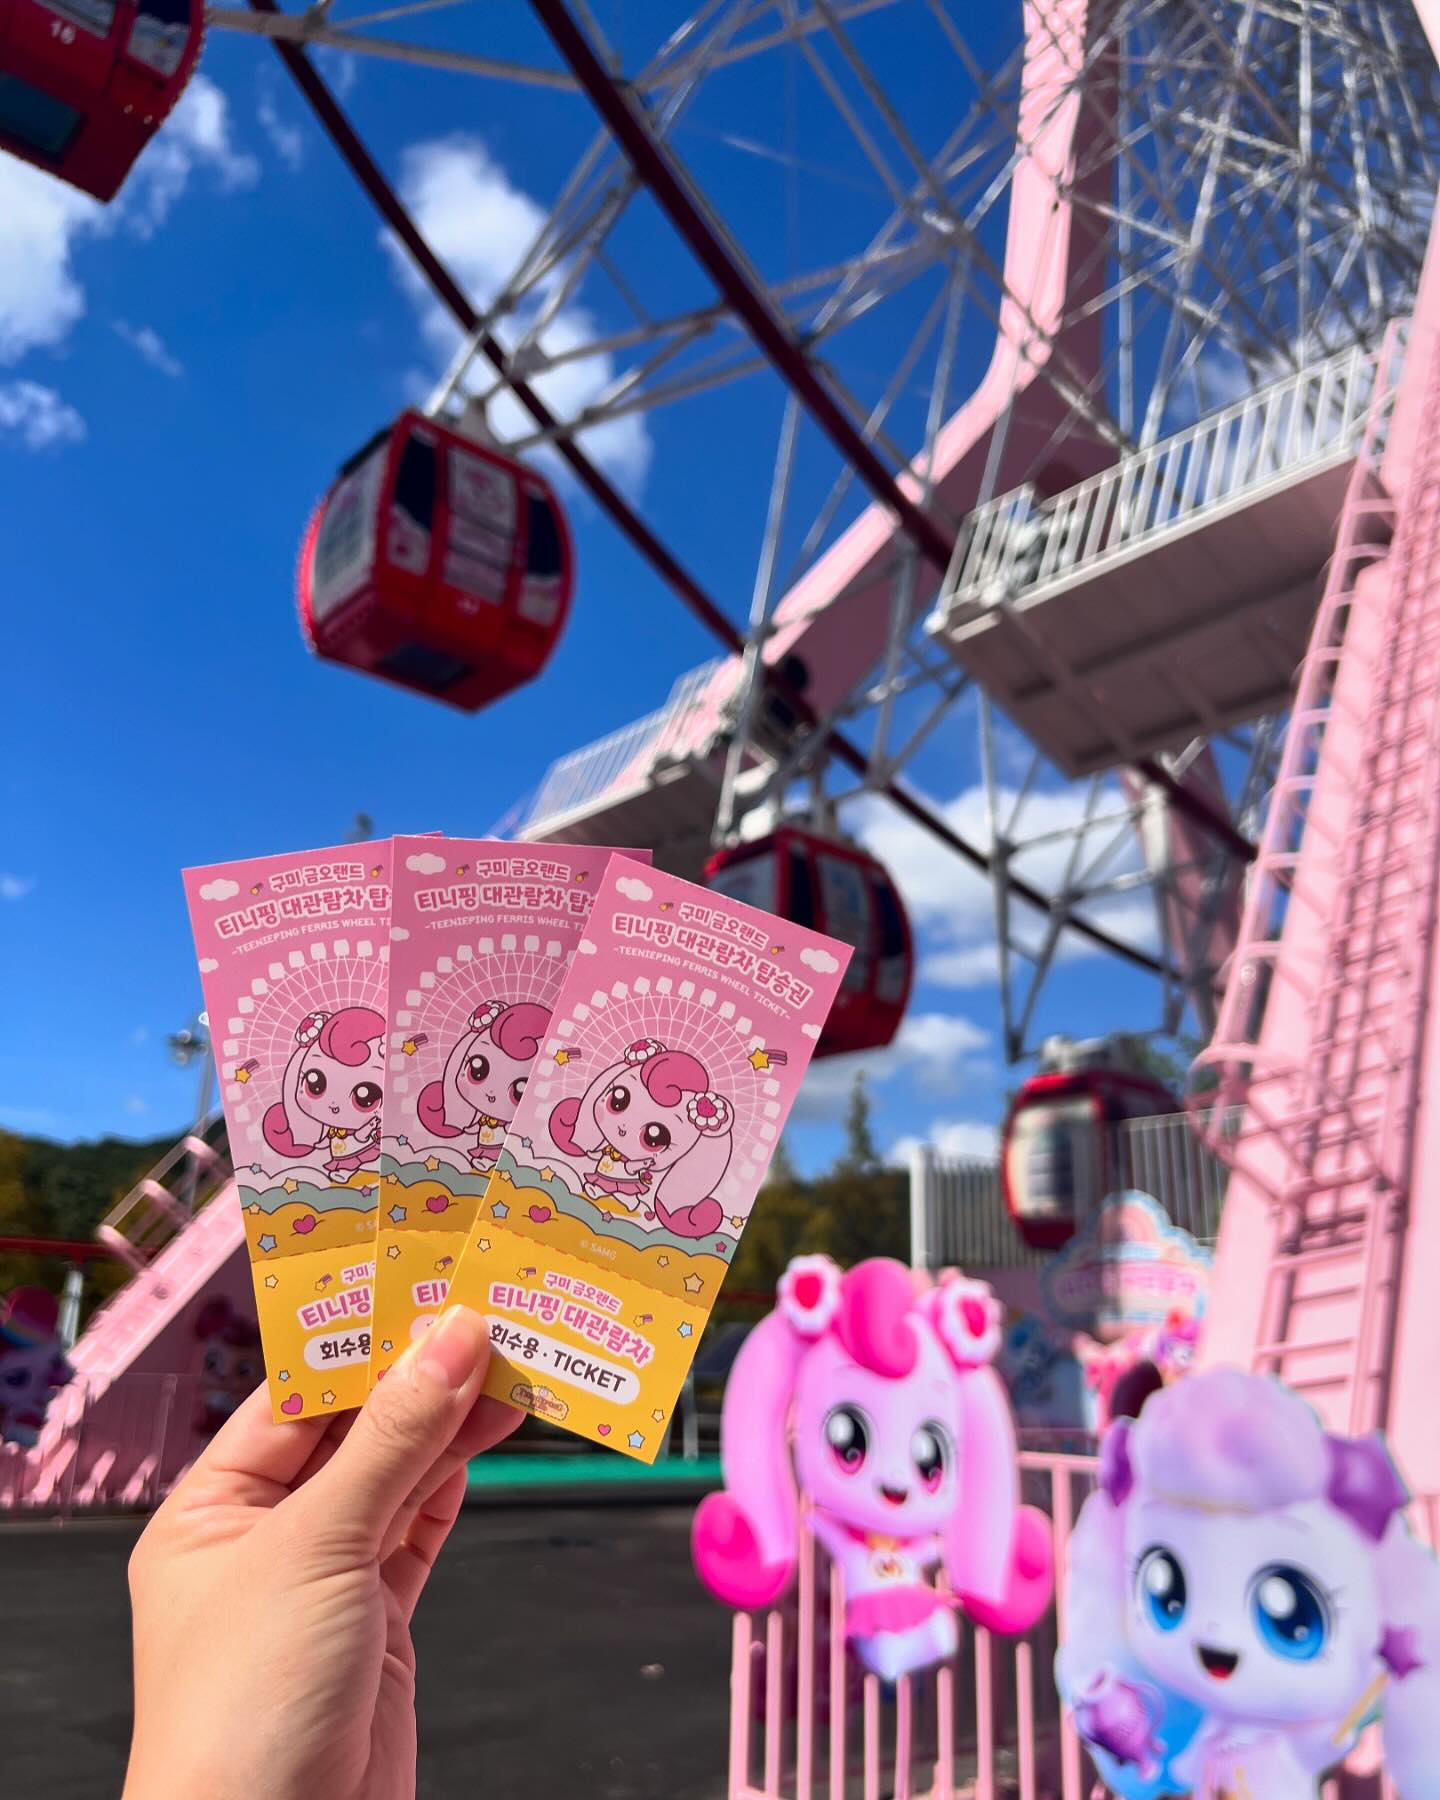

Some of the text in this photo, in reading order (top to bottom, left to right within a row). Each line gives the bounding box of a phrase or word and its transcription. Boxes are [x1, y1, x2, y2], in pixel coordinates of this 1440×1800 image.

[270, 863, 364, 891] 구미 금오랜드
[477, 859, 570, 882] 구미 금오랜드
[217, 901, 279, 937] 티니핑
[280, 887, 364, 917] 대관람차
[415, 884, 478, 911] 티니핑
[481, 884, 566, 909] 대관람차
[302, 919, 340, 935] FERRIS
[341, 917, 377, 928] WHEEL
[496, 914, 535, 924] FERRIS
[537, 916, 571, 929] WHEEL
[679, 903, 769, 951] 구미 금오랜드
[613, 914, 812, 1008] 티니핑 대관람차 탑승권
[682, 959, 719, 980] FERRIS
[720, 973, 751, 997] WHEEL
[342, 1263, 370, 1284] 구미
[300, 1286, 372, 1328] 티니핑
[544, 1272, 622, 1314] 구미 금오랜드
[490, 1284, 653, 1365] 티니핑 대관람차
[319, 1333, 371, 1361] 회수용
[488, 1322, 540, 1360] 회수용
[554, 1349, 627, 1393] TICKET
